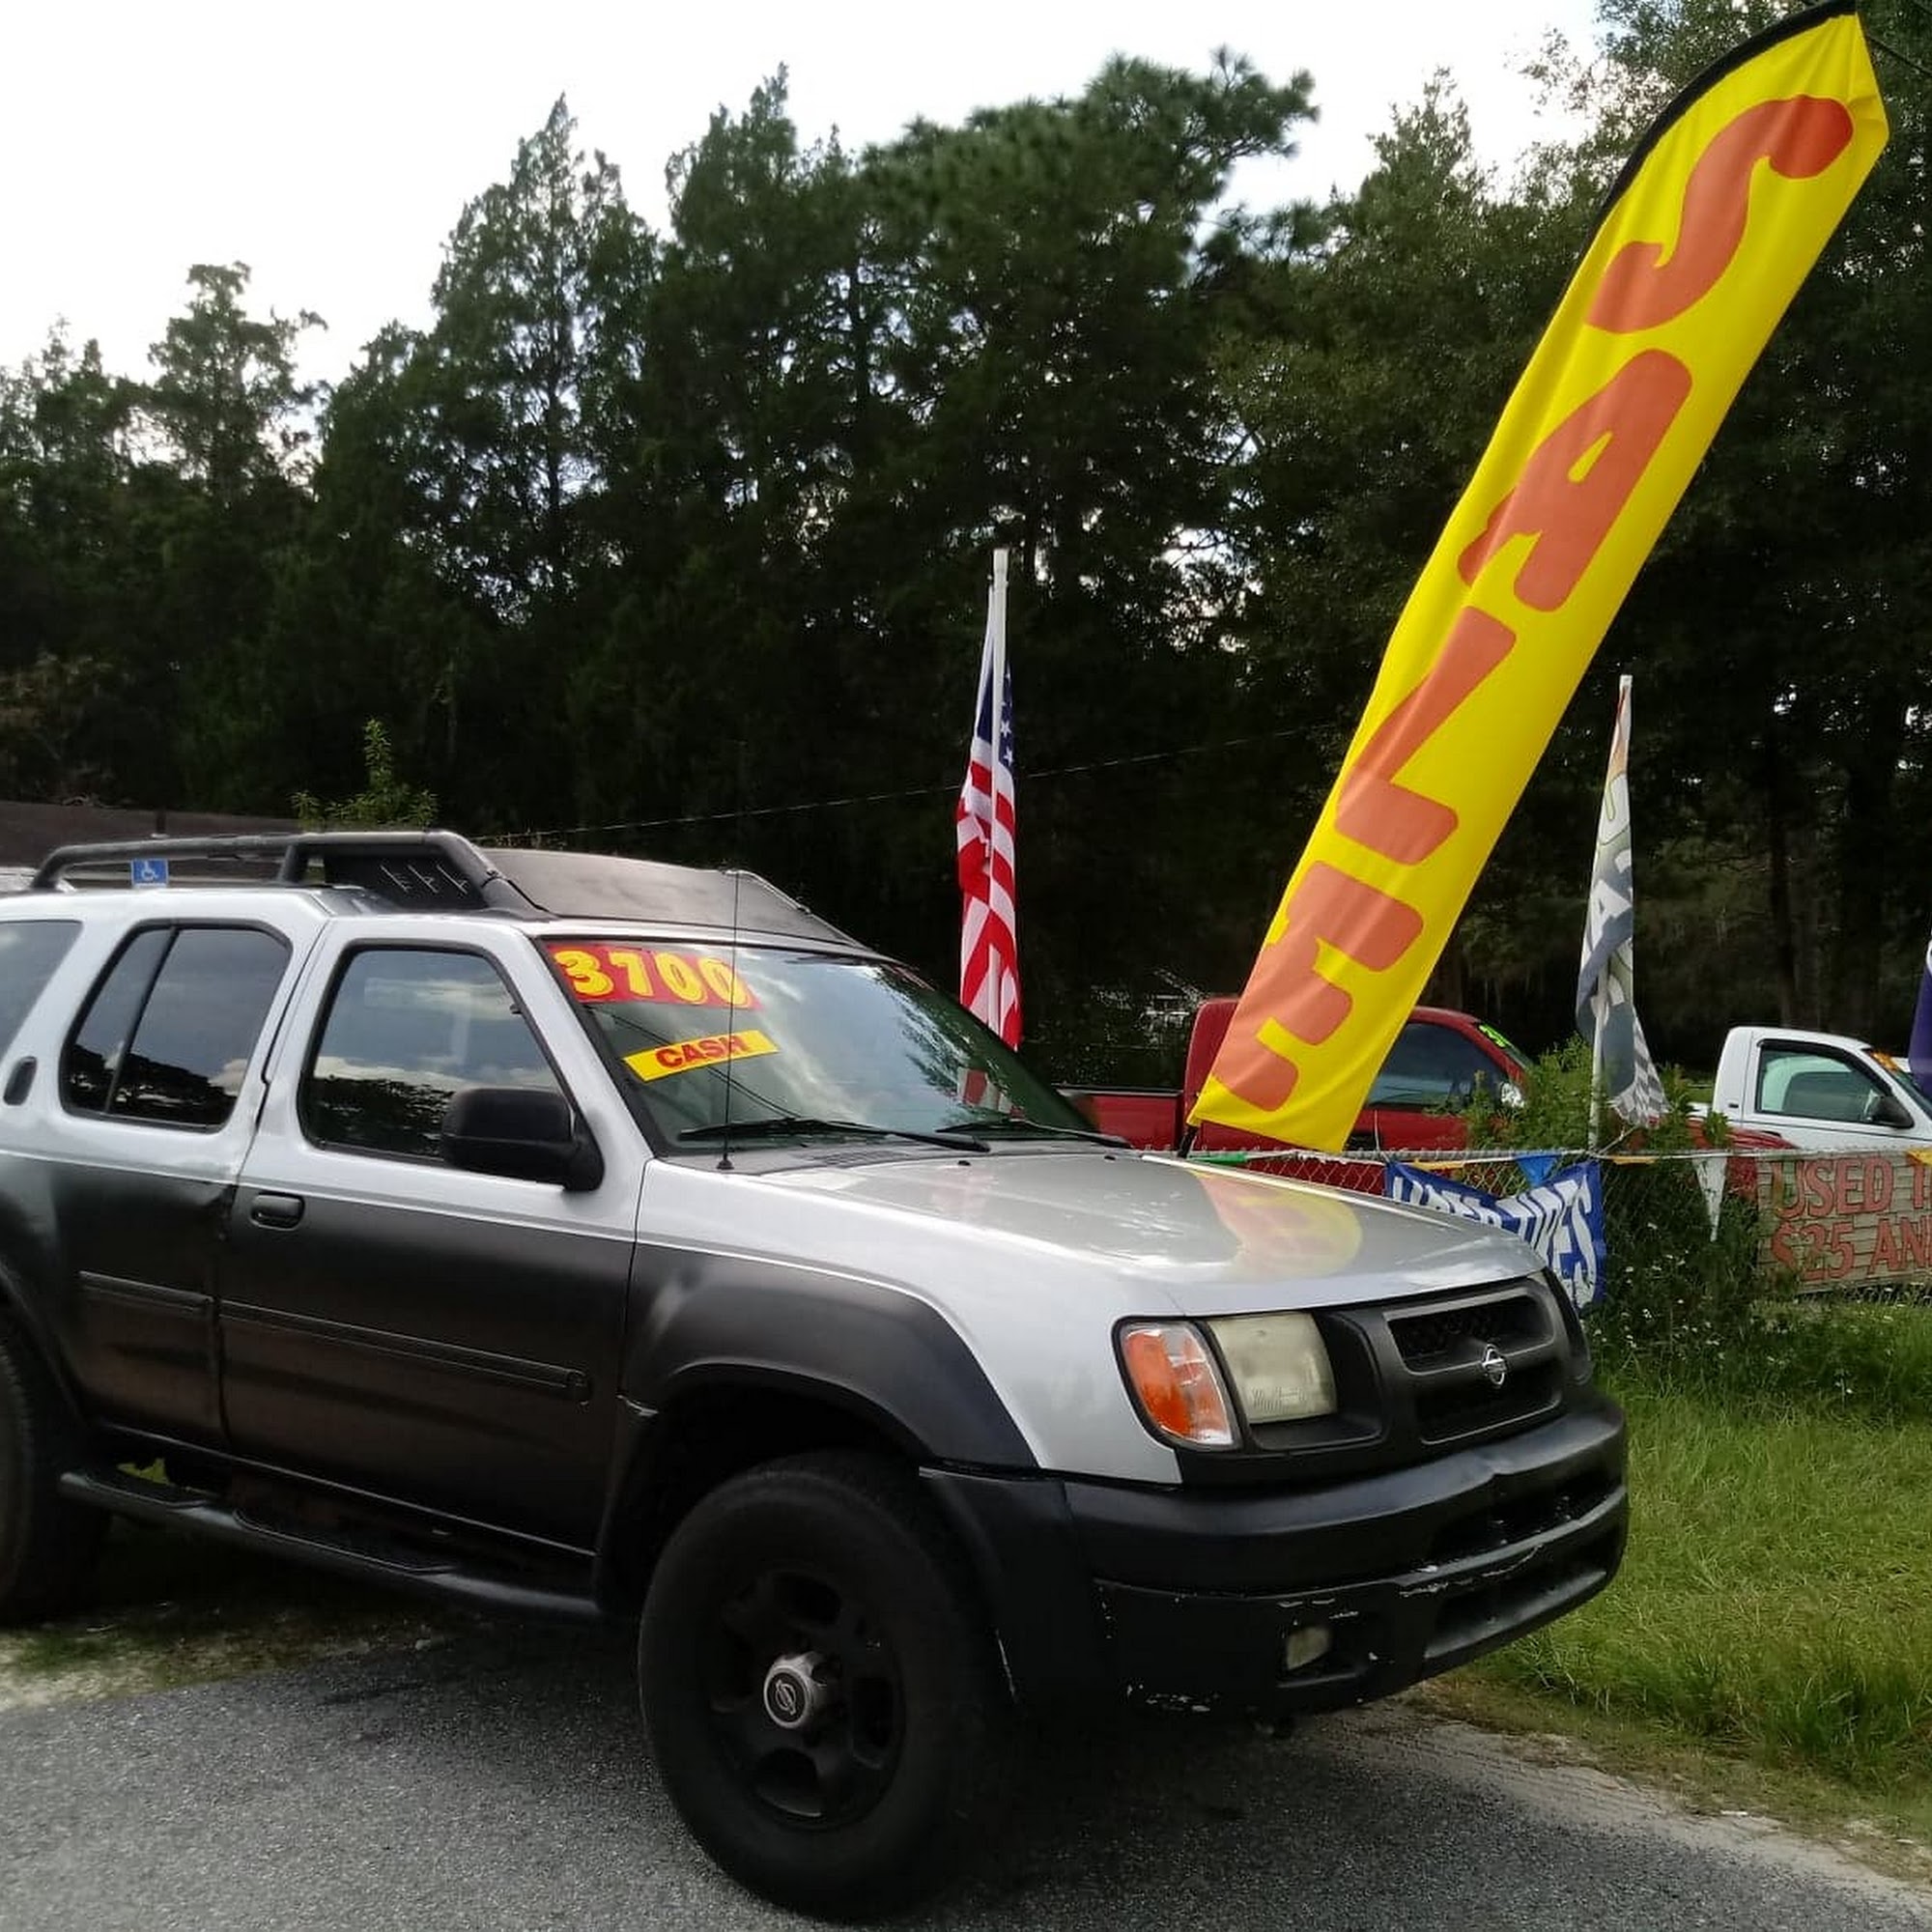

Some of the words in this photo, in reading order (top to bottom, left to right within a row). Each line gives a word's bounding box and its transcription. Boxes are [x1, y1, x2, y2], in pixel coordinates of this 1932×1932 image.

[1211, 95, 1853, 1112] SALE
[554, 951, 753, 1009] 3700
[655, 1035, 752, 1069] CASH
[1772, 1154, 1893, 1218] USED
[1866, 1215, 1932, 1276] AN
